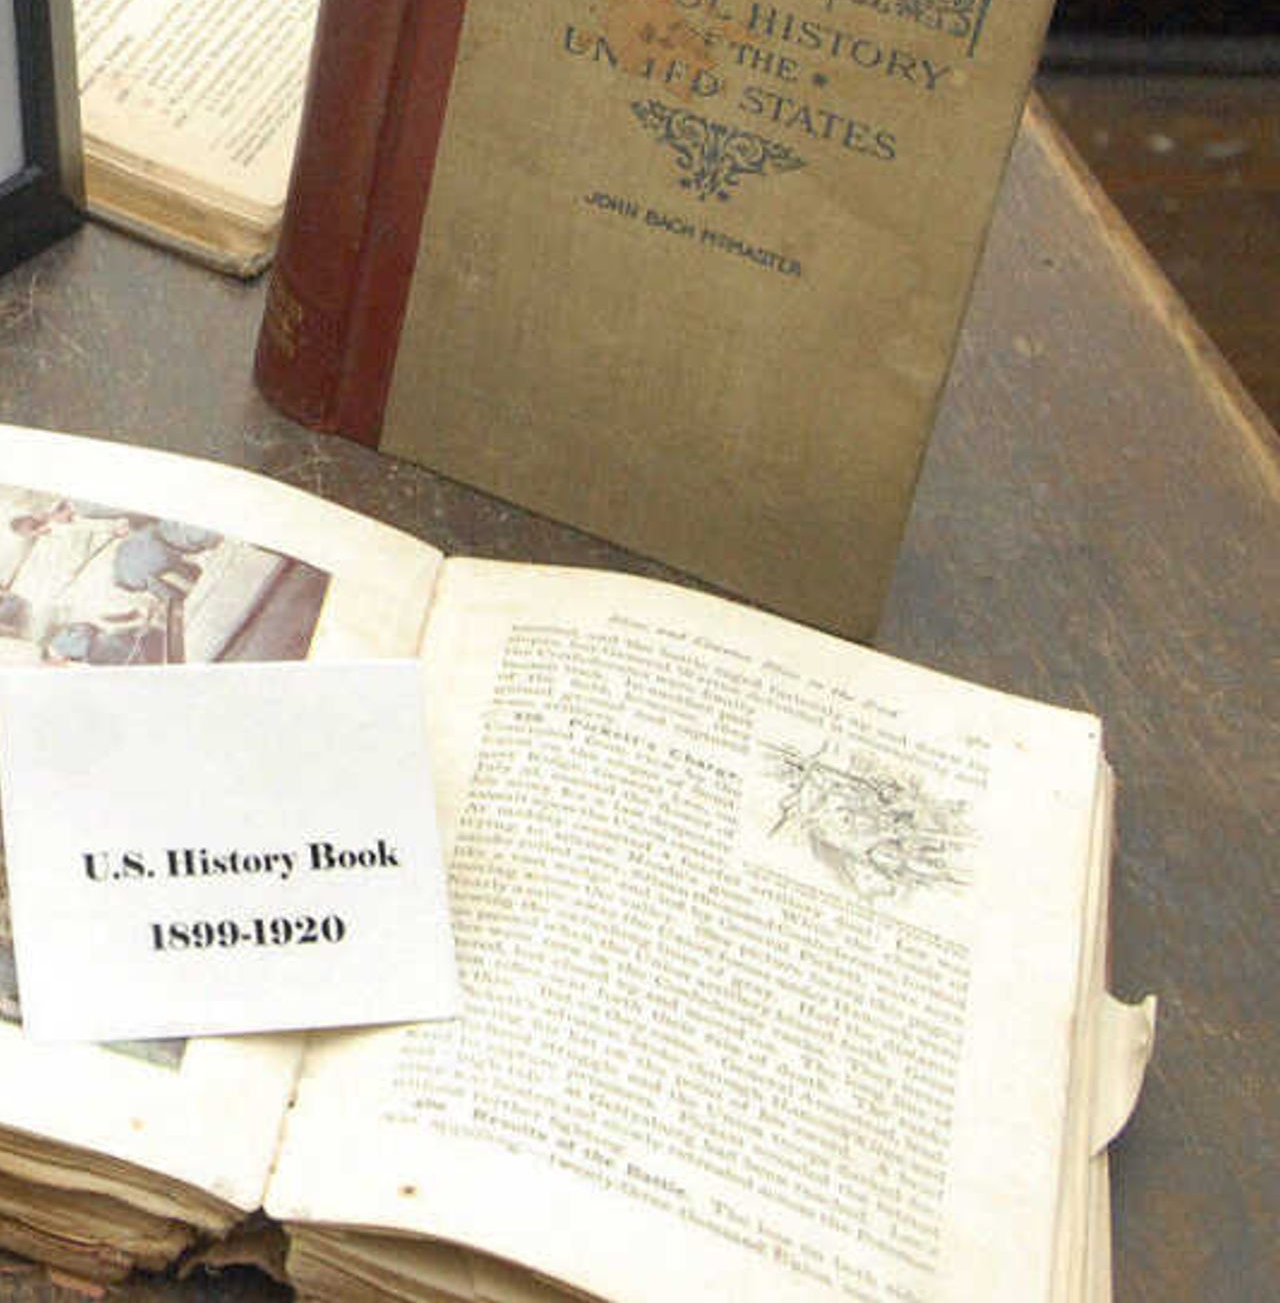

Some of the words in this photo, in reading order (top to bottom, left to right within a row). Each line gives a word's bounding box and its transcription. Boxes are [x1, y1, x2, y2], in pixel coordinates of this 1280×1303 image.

[729, 41, 799, 82] THE
[747, 1, 951, 91] HISTORY
[563, 24, 722, 97] UNTED
[739, 84, 897, 161] STATES
[584, 191, 638, 218] JOHN
[81, 849, 156, 885] U.S.
[166, 846, 297, 881] History
[306, 838, 400, 873] Book
[150, 912, 347, 953] 1899-1920
